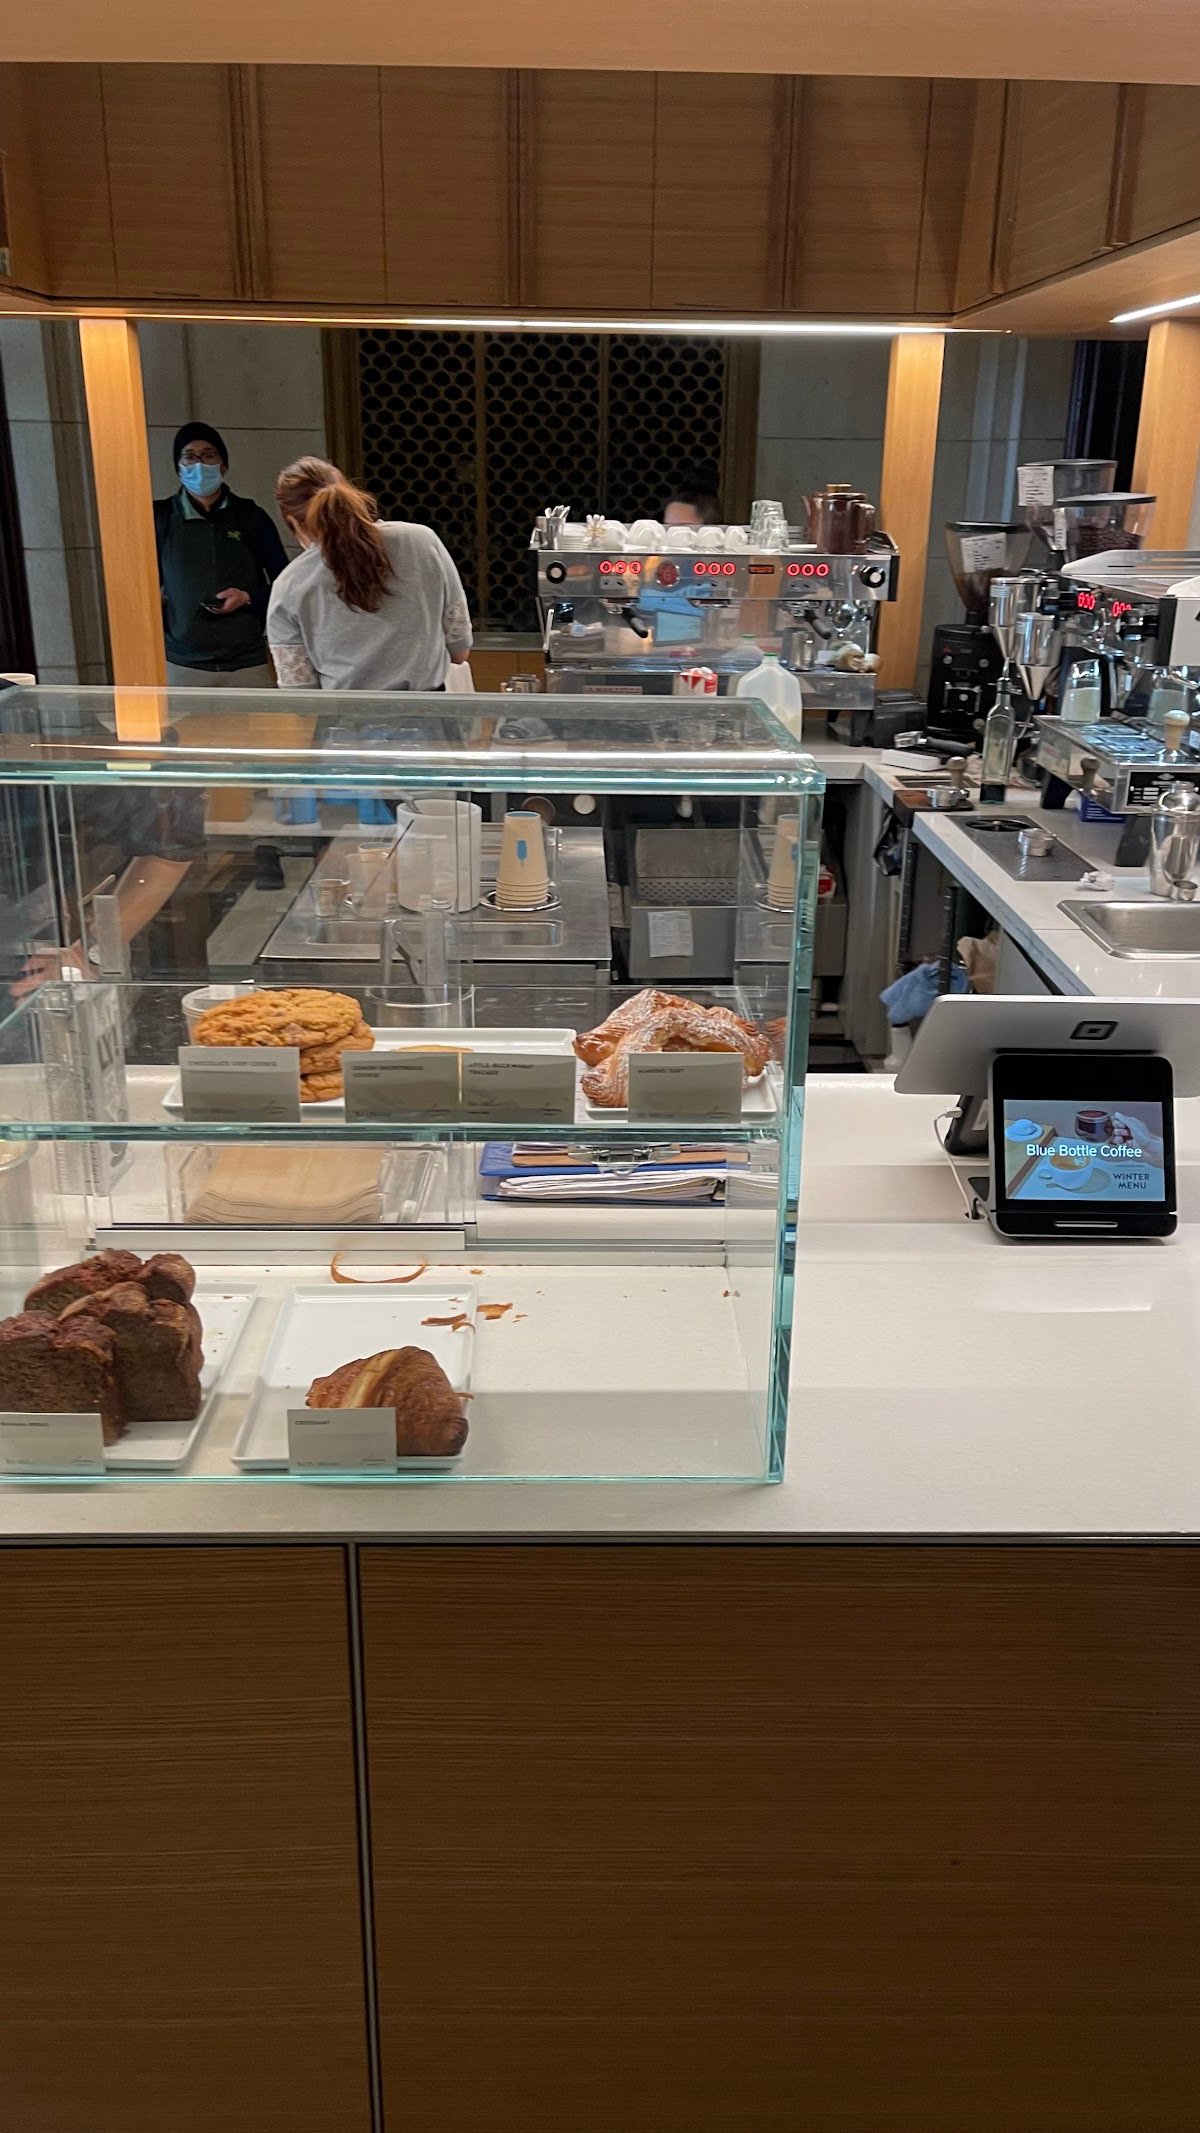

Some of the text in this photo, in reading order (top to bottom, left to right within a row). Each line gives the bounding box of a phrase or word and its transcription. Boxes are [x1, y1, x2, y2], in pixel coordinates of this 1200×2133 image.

[1026, 1144, 1143, 1158] Blue Bottle Coffee
[1112, 1172, 1150, 1181] WINTER
